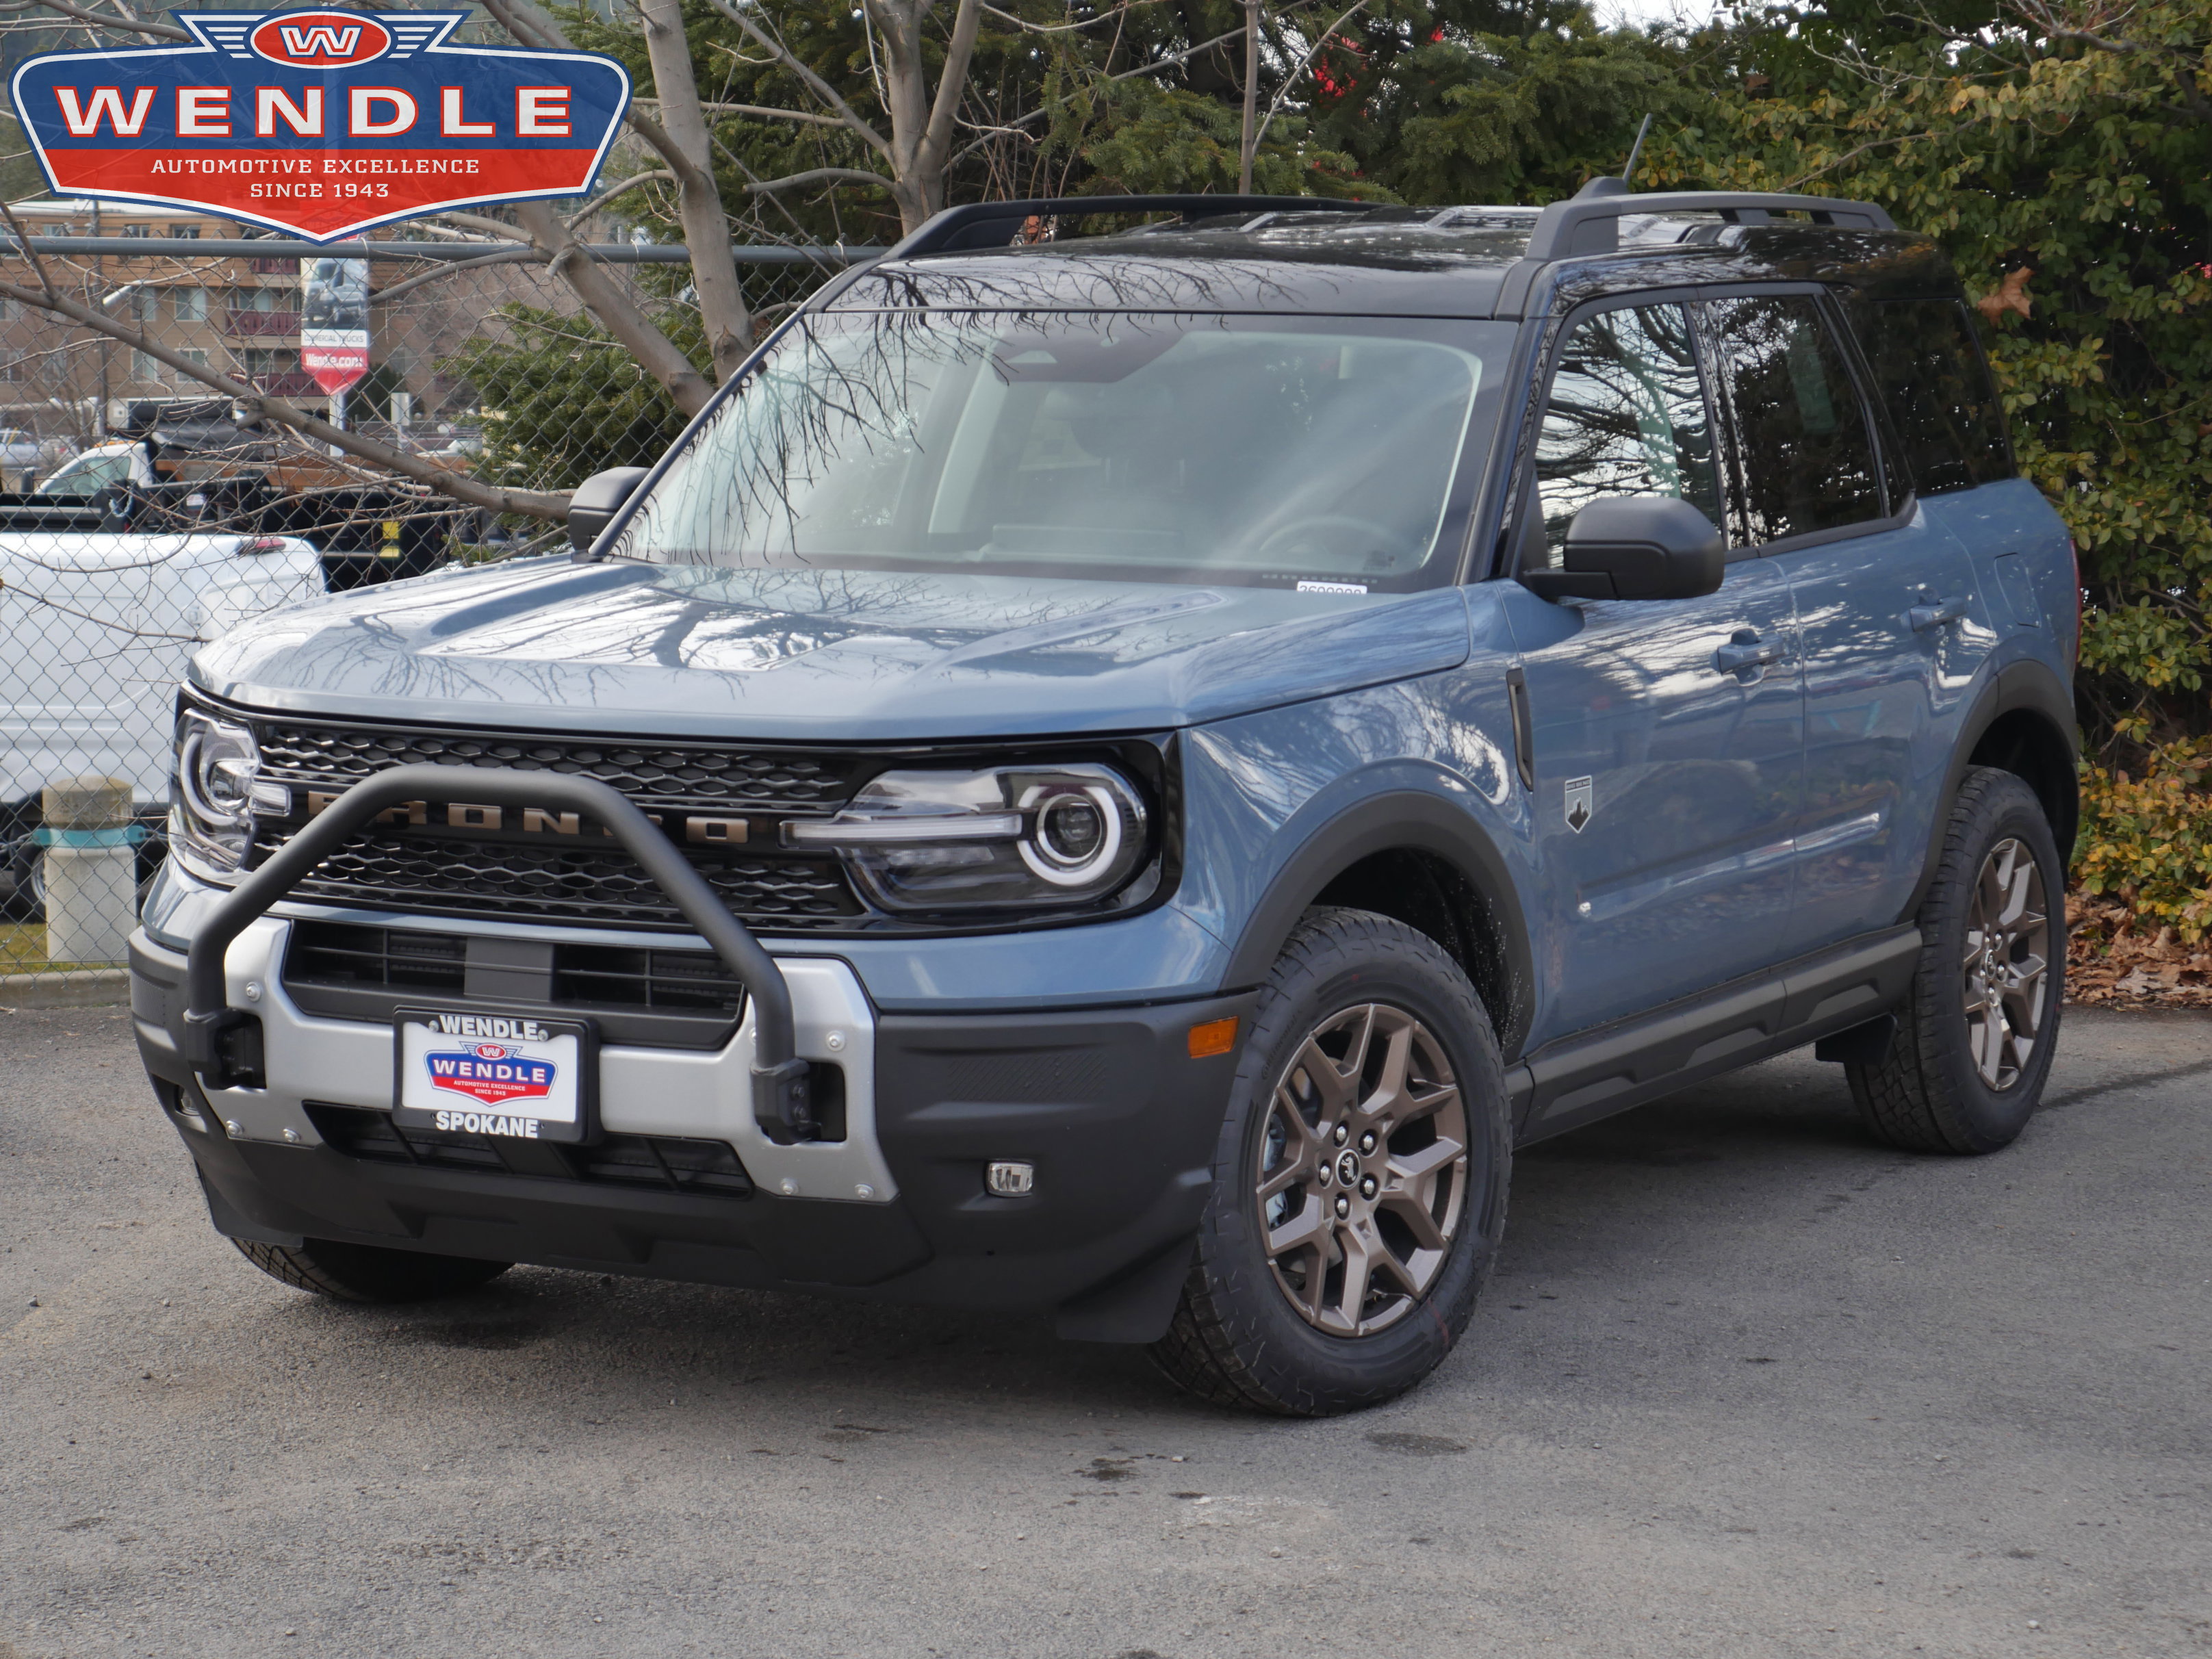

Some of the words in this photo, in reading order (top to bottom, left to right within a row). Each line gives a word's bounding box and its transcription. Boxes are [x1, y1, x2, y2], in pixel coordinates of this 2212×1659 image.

[308, 790, 748, 843] RONO
[439, 1015, 539, 1040] WENDLE
[433, 1059, 545, 1083] WENDLE
[454, 1080, 489, 1088] AUTOMOTIVE
[436, 1110, 538, 1138] SPOKANE
